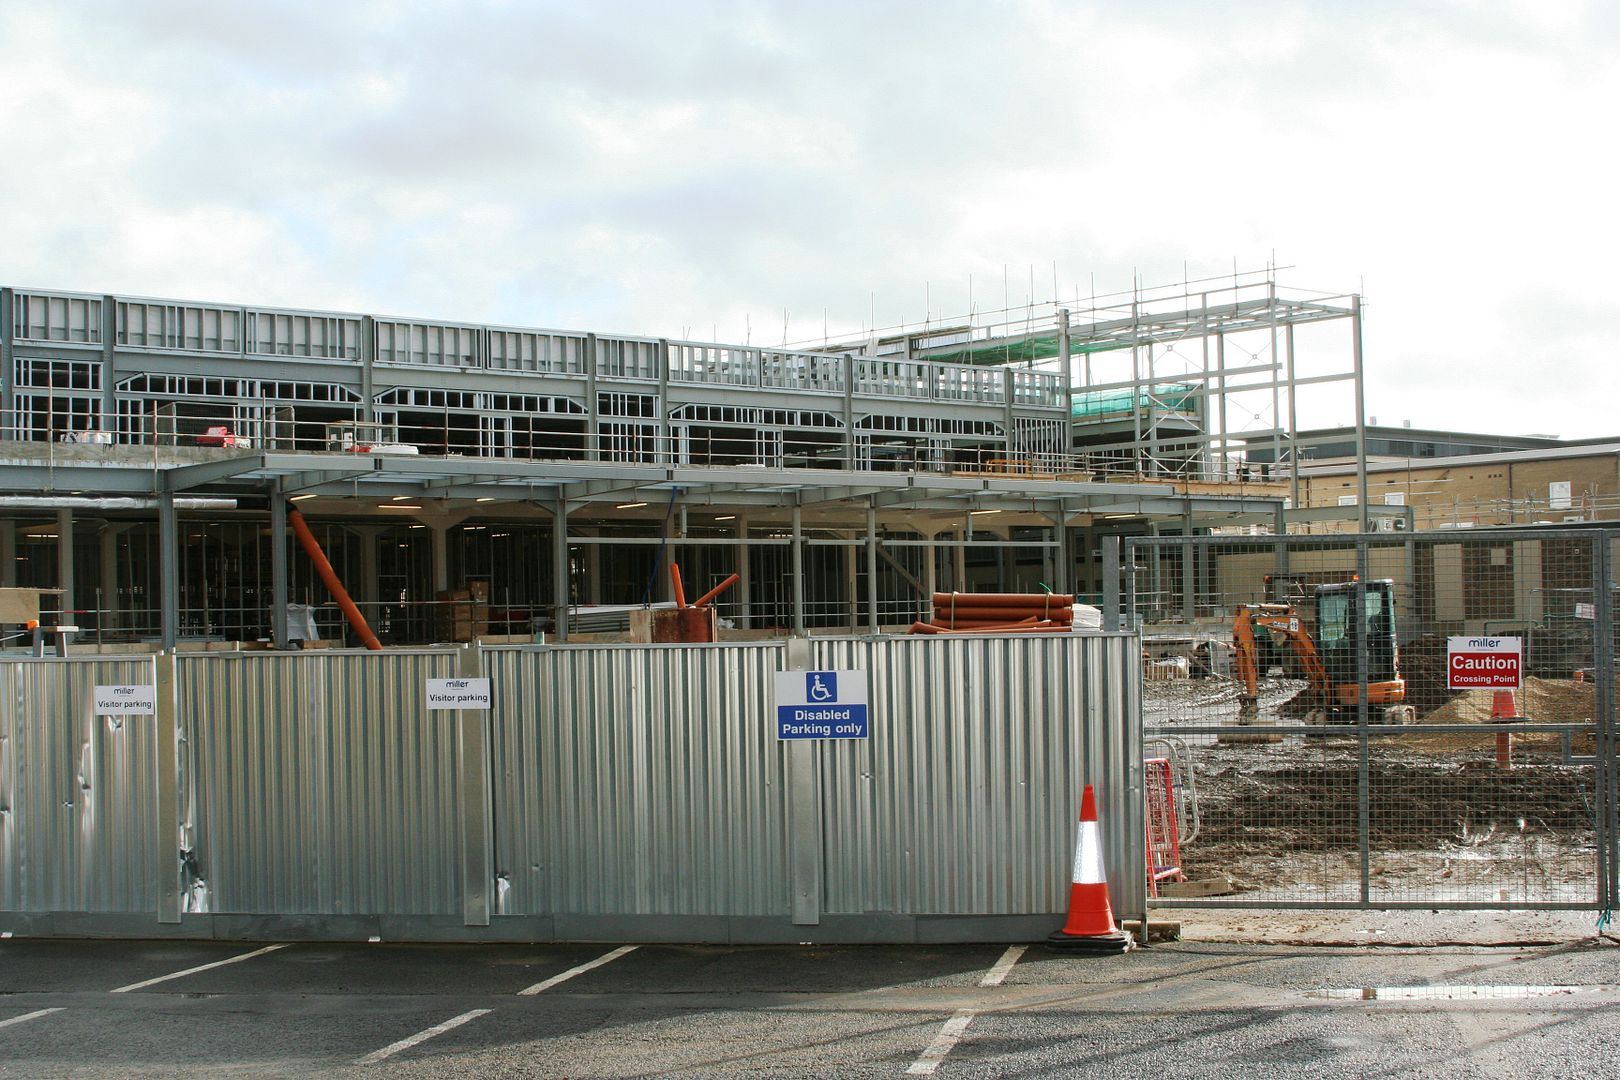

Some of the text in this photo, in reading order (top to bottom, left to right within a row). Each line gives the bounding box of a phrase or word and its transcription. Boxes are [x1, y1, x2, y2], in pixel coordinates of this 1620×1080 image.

[1468, 638, 1501, 648] miller
[1452, 655, 1517, 670] Caution
[445, 680, 469, 688] miller
[1453, 675, 1516, 684] Crossing Point
[113, 687, 135, 695] miller
[429, 693, 488, 703] Visitor parking
[124, 700, 152, 709] parking
[794, 709, 850, 721] Disabled
[782, 723, 862, 736] Parking only
